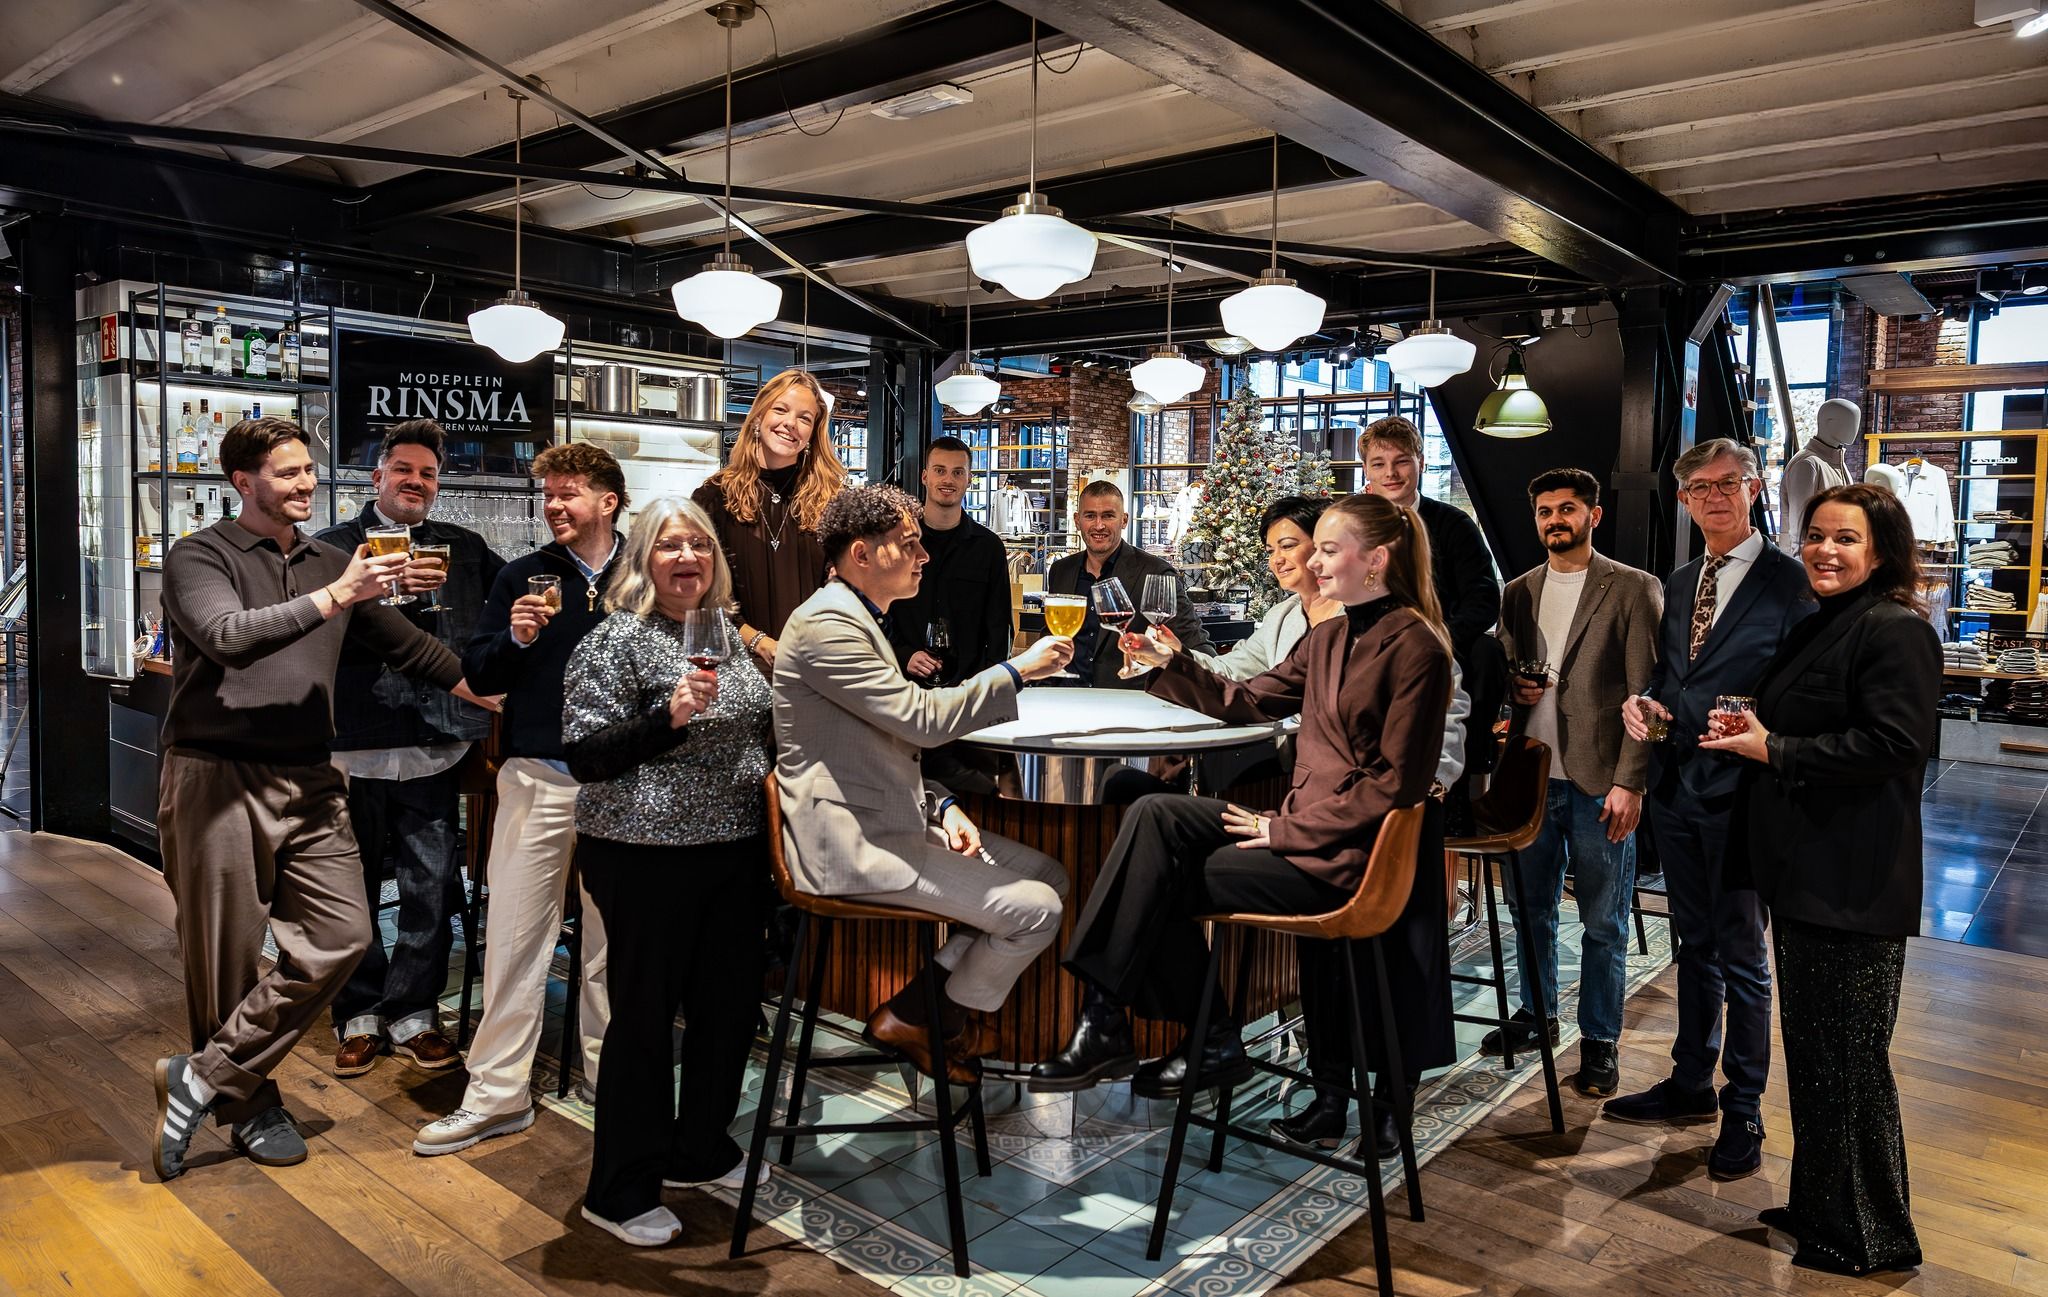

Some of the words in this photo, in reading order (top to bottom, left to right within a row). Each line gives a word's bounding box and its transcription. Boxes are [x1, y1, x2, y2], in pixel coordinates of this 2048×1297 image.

[400, 373, 502, 387] MODEPLEIN
[367, 385, 531, 423] RINSMA
[439, 422, 465, 432] EREN
[468, 423, 489, 432] VAN
[1993, 639, 2025, 648] CAST
